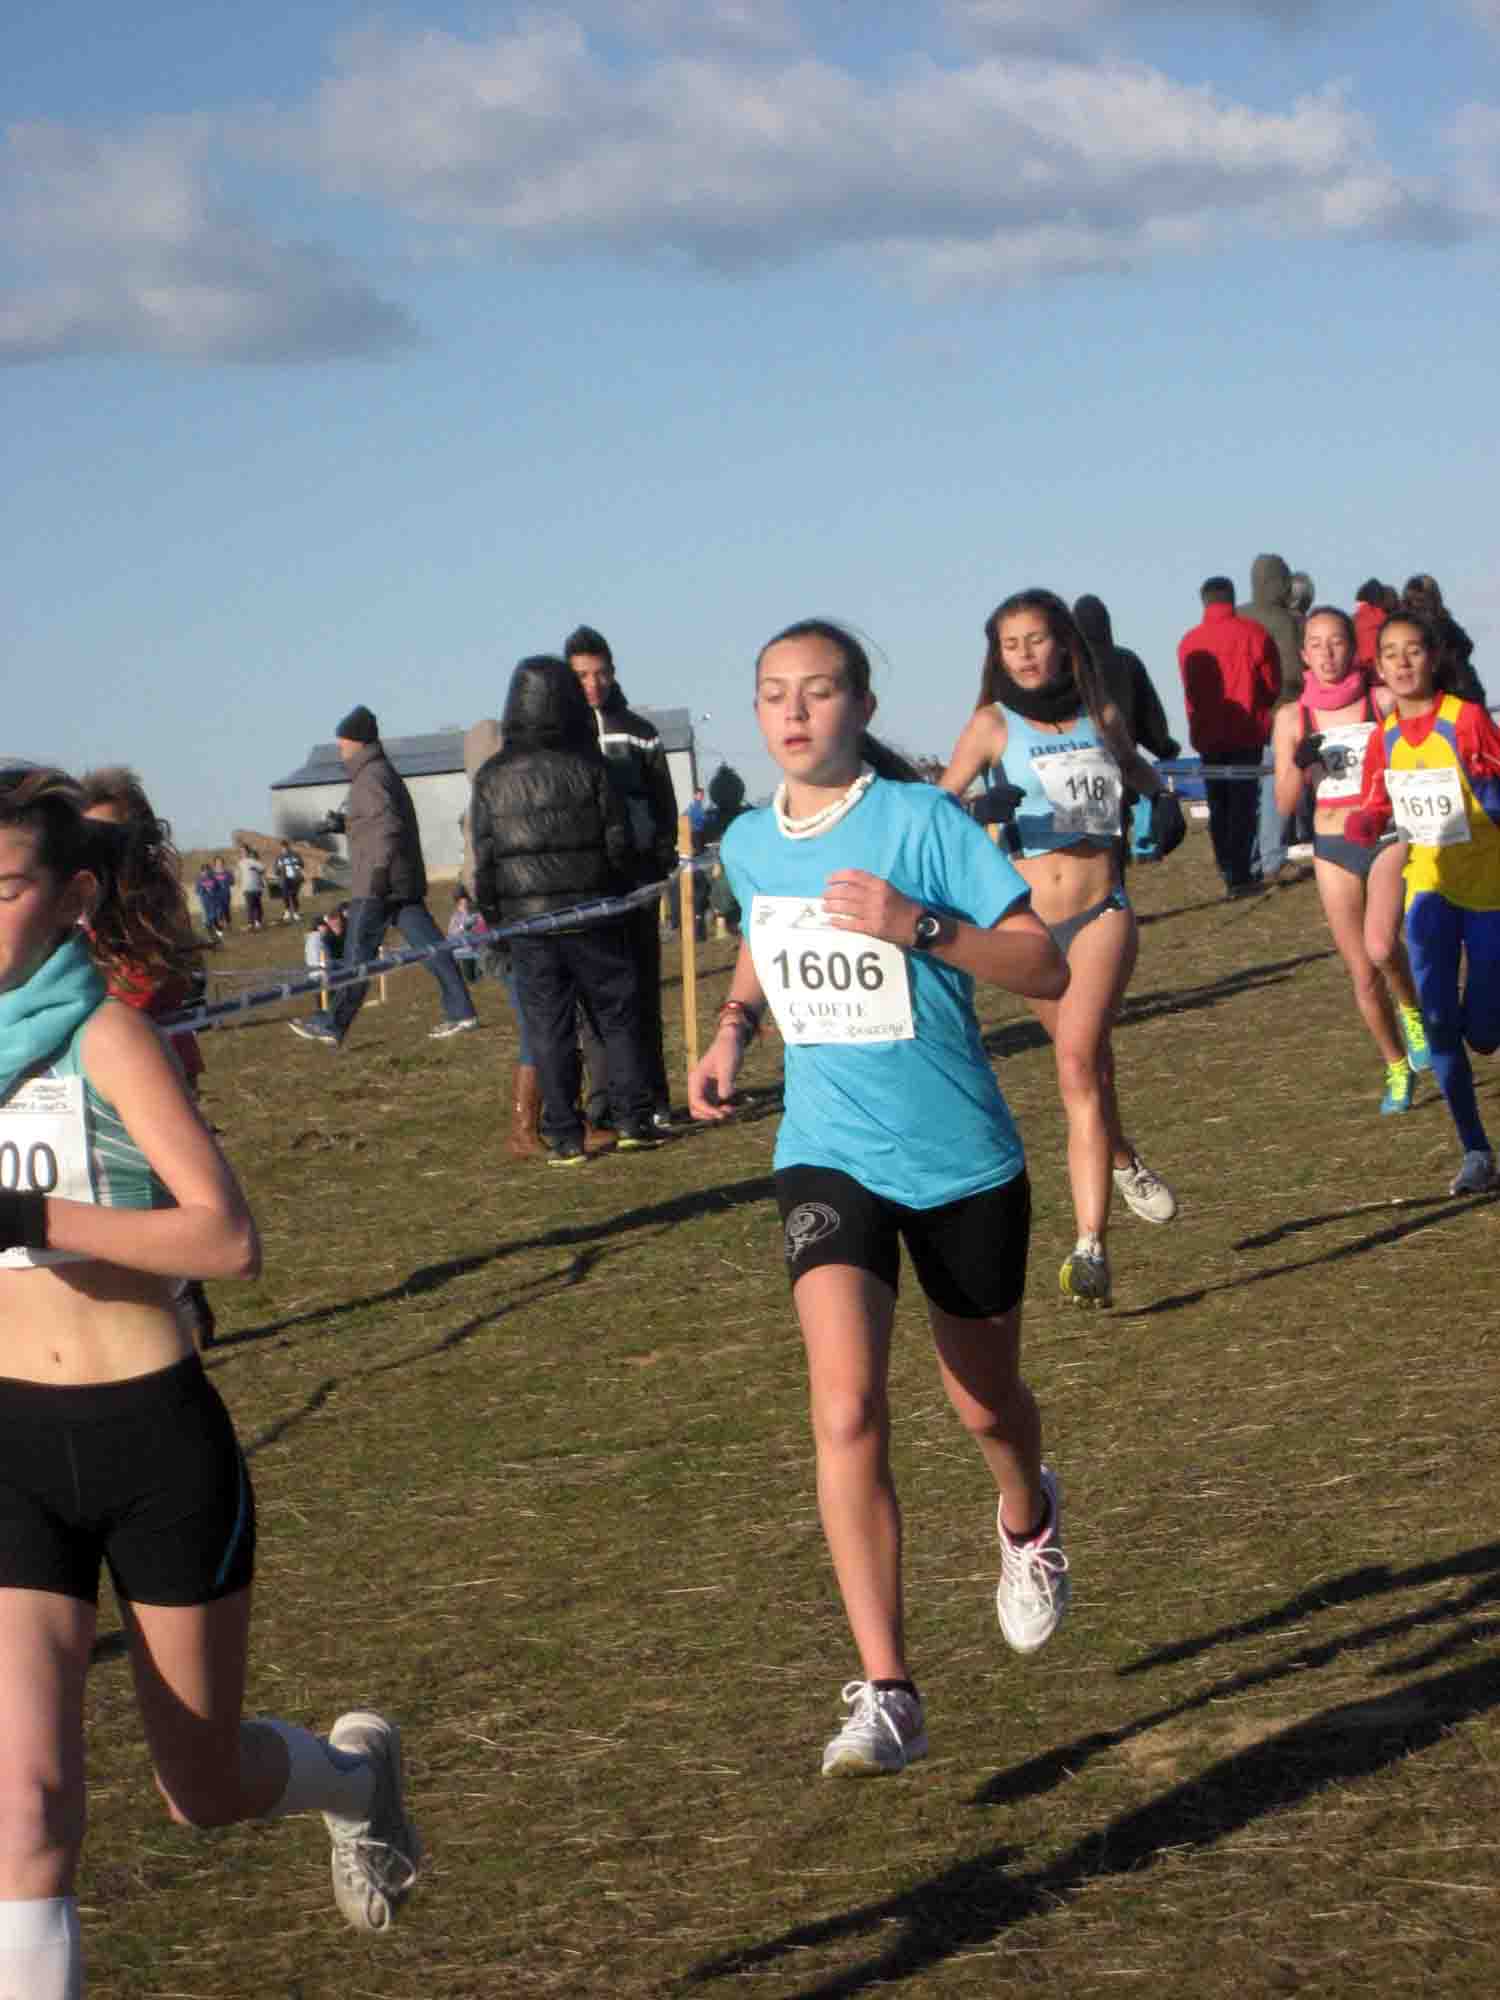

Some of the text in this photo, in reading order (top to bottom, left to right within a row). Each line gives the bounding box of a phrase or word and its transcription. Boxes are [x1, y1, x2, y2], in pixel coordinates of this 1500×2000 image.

[1066, 775, 1105, 801] 118
[1400, 794, 1453, 817] 1619
[772, 948, 884, 991] 1606
[789, 1000, 867, 1018] CADETE
